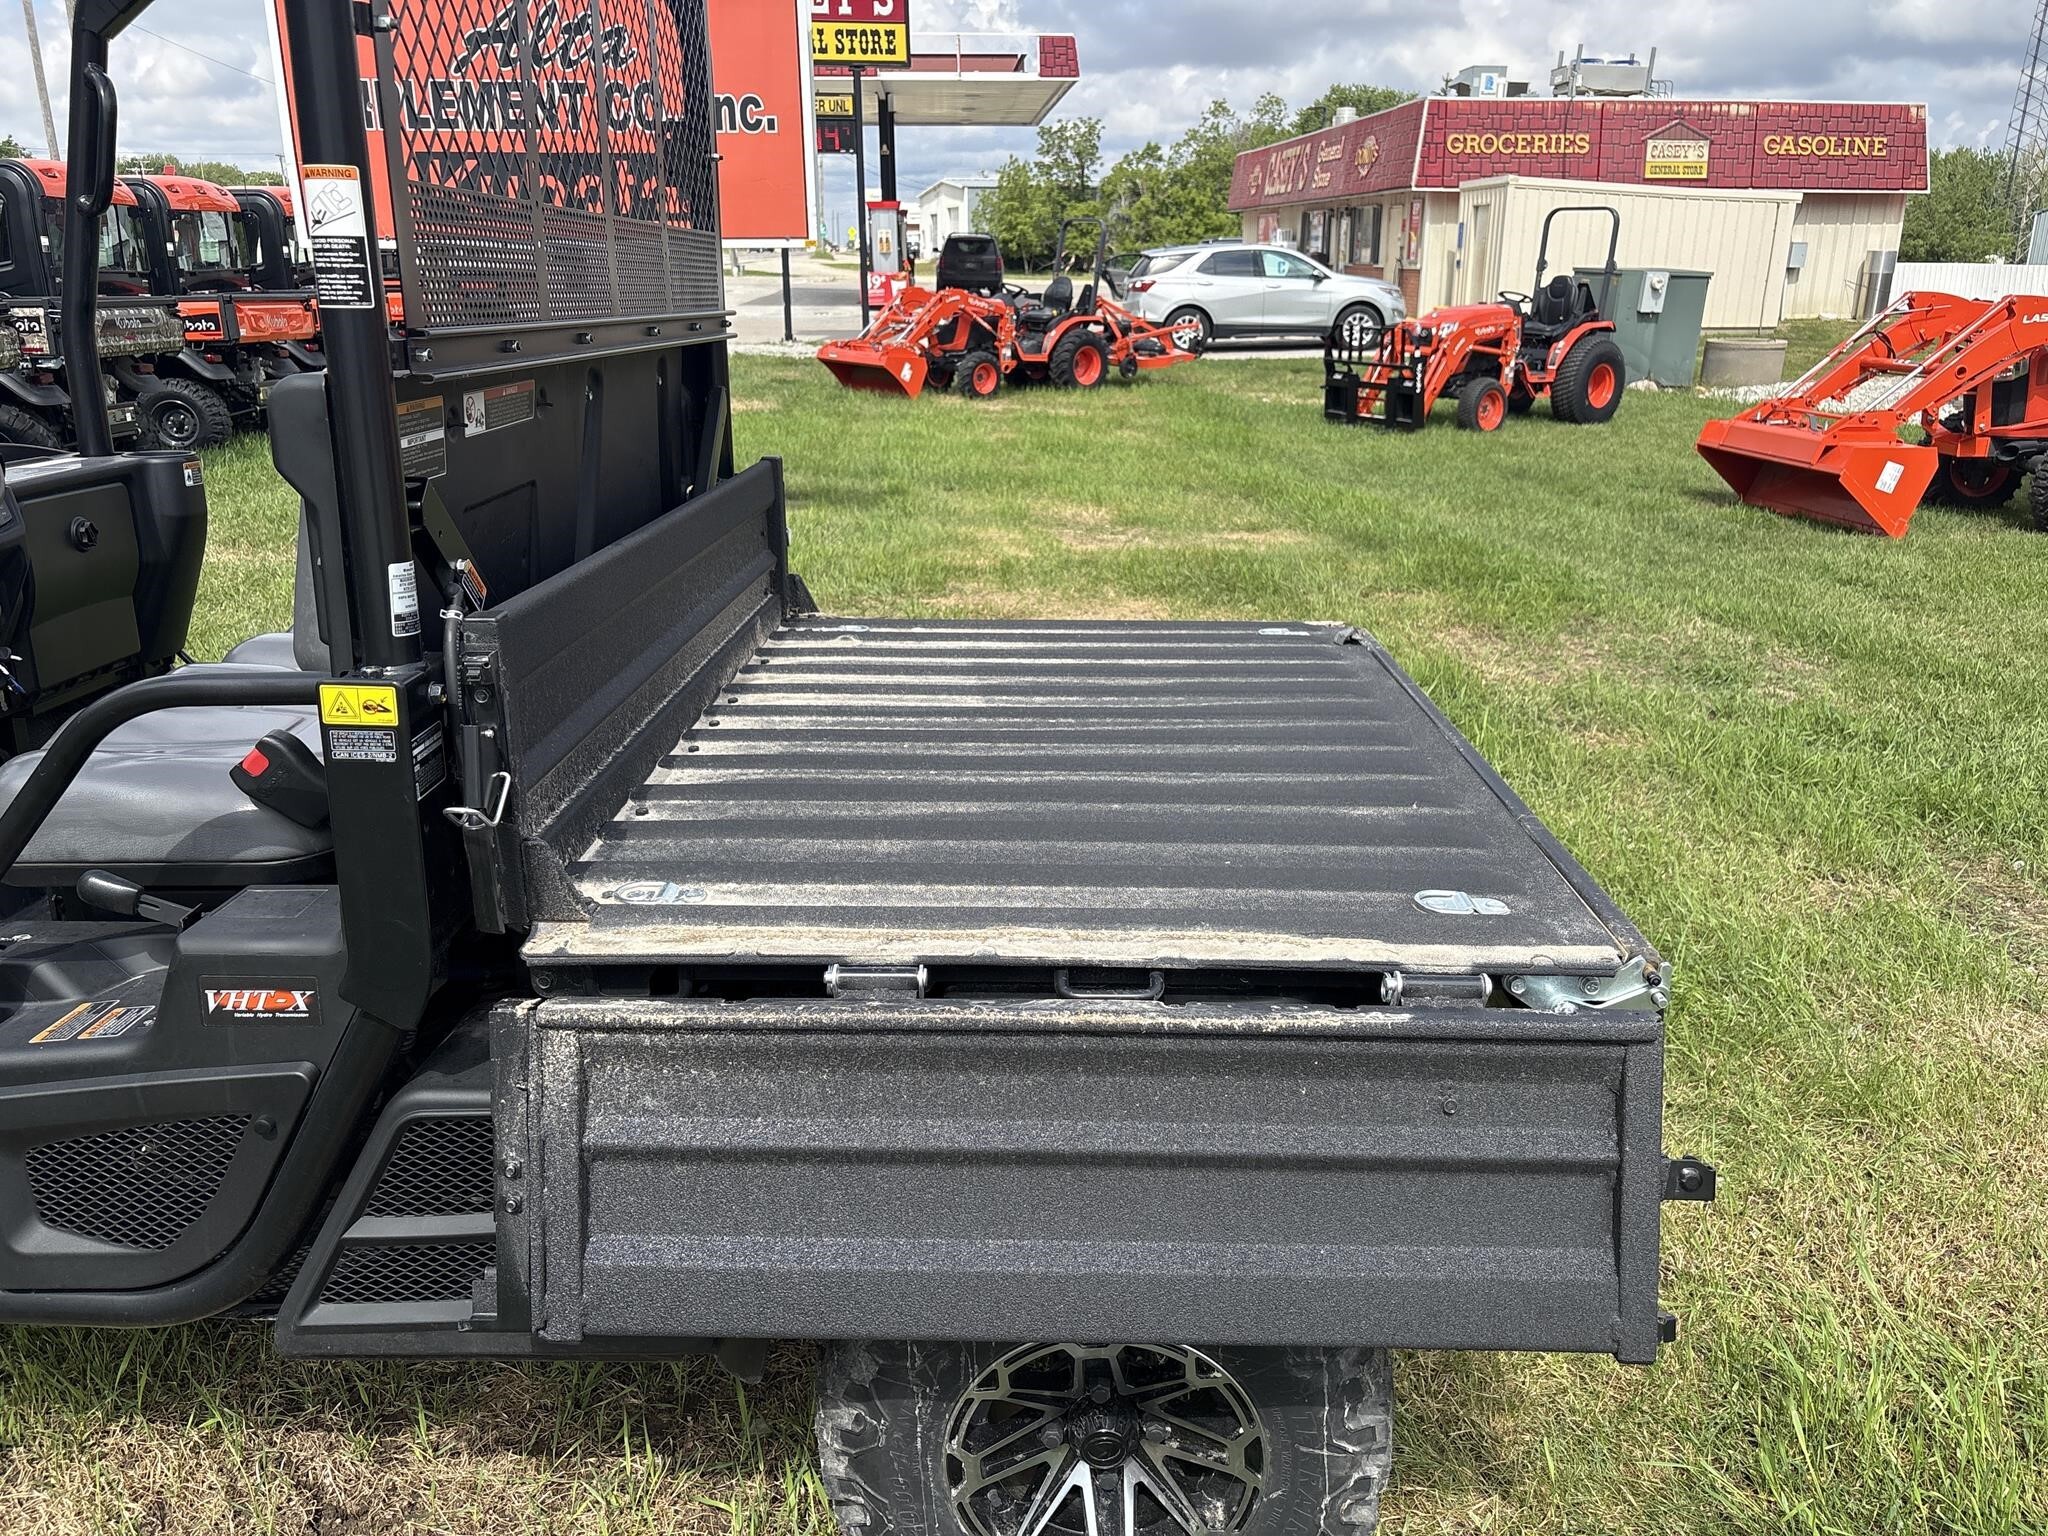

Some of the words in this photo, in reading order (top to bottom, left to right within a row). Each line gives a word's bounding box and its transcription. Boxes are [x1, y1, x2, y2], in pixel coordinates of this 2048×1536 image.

[834, 28, 896, 55] STORE
[714, 93, 778, 134] nc.
[829, 100, 849, 112] UNL
[1446, 132, 1590, 155] GROCERIES
[1650, 141, 1705, 159] CASEY'S
[1763, 135, 1888, 157] GASOLINE
[309, 167, 352, 179] WARNING
[1264, 142, 1312, 196] CASEY'S
[1649, 164, 1681, 176] GENERAL
[1682, 165, 1704, 176] STORE
[115, 317, 142, 329] Kubota
[265, 314, 288, 328] Kubota
[205, 989, 317, 1015] VHT-X
